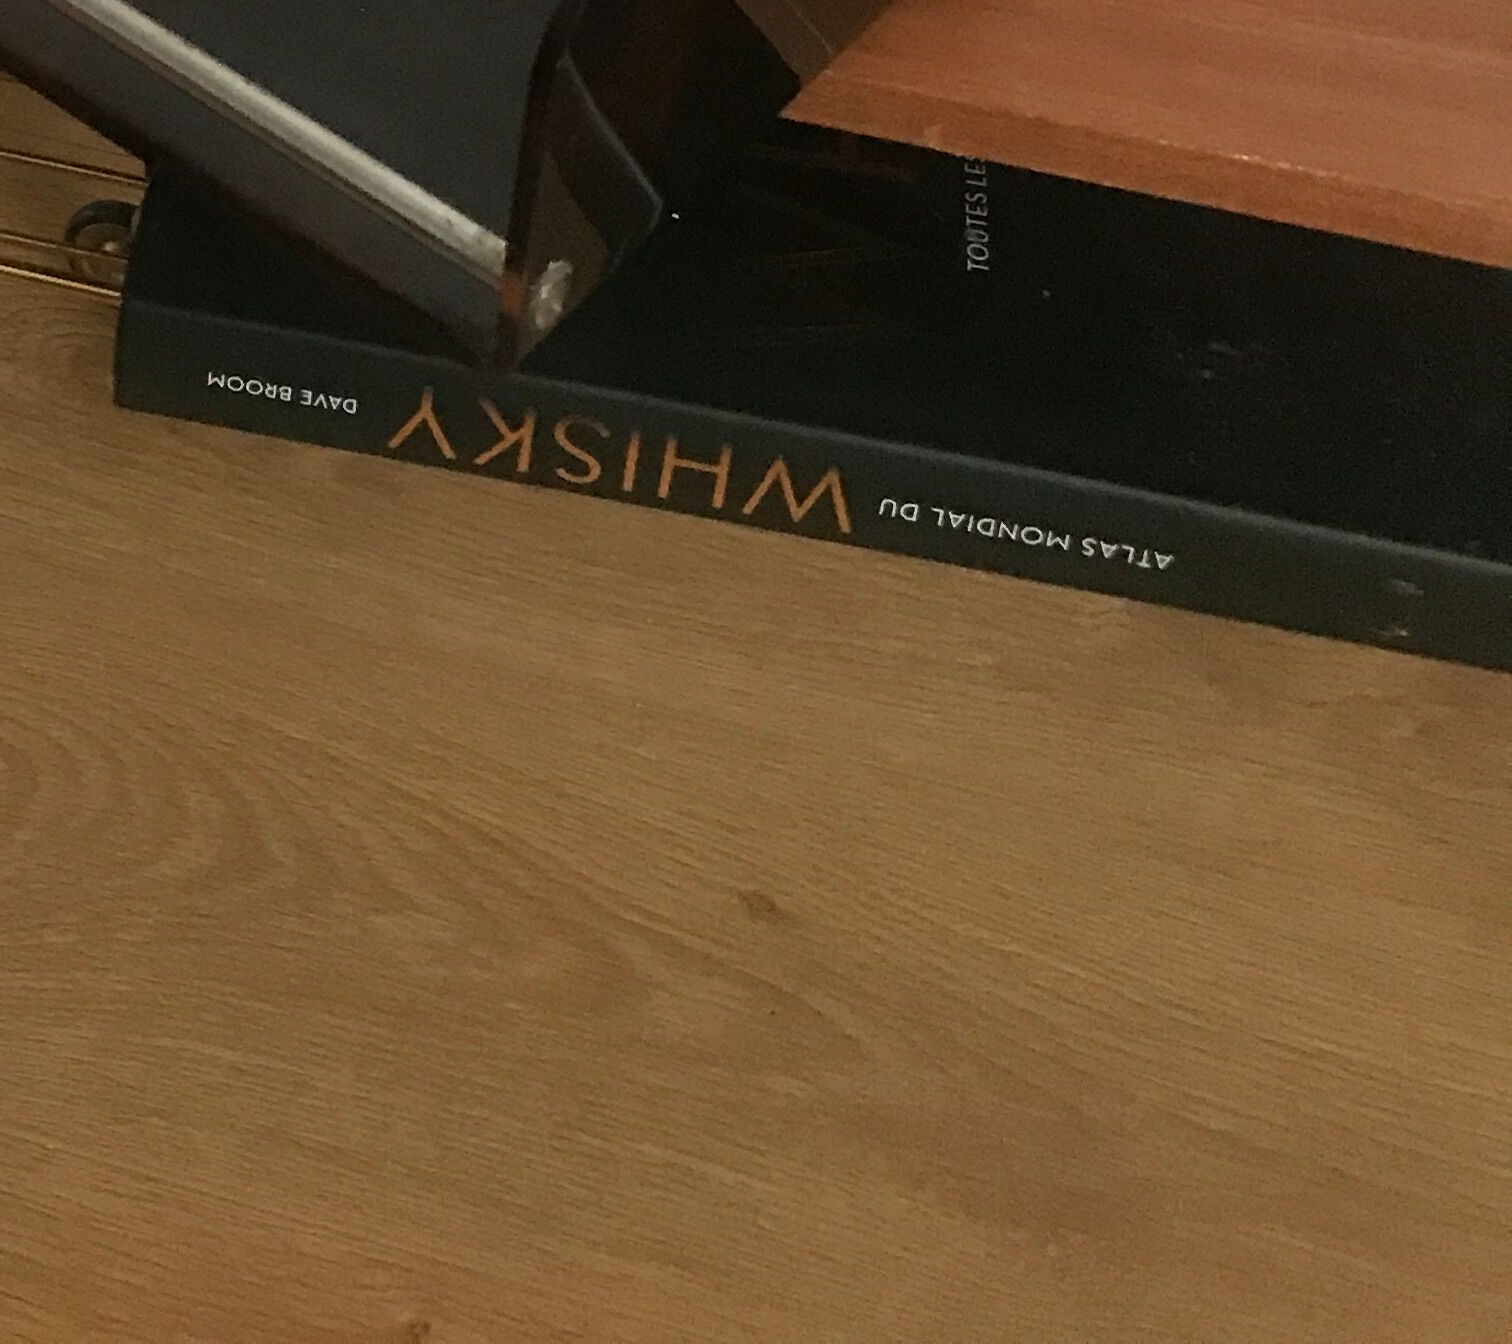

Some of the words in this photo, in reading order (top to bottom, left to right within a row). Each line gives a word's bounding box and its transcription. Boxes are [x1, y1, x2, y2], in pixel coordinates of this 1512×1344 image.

[964, 192, 990, 271] TOUTES
[207, 371, 293, 402] BROOM
[300, 389, 358, 414] DAVE
[390, 387, 851, 534] WHISKY
[878, 498, 919, 522] DU
[931, 507, 1070, 551] MONDIAL
[1081, 537, 1175, 570] ATLAS
